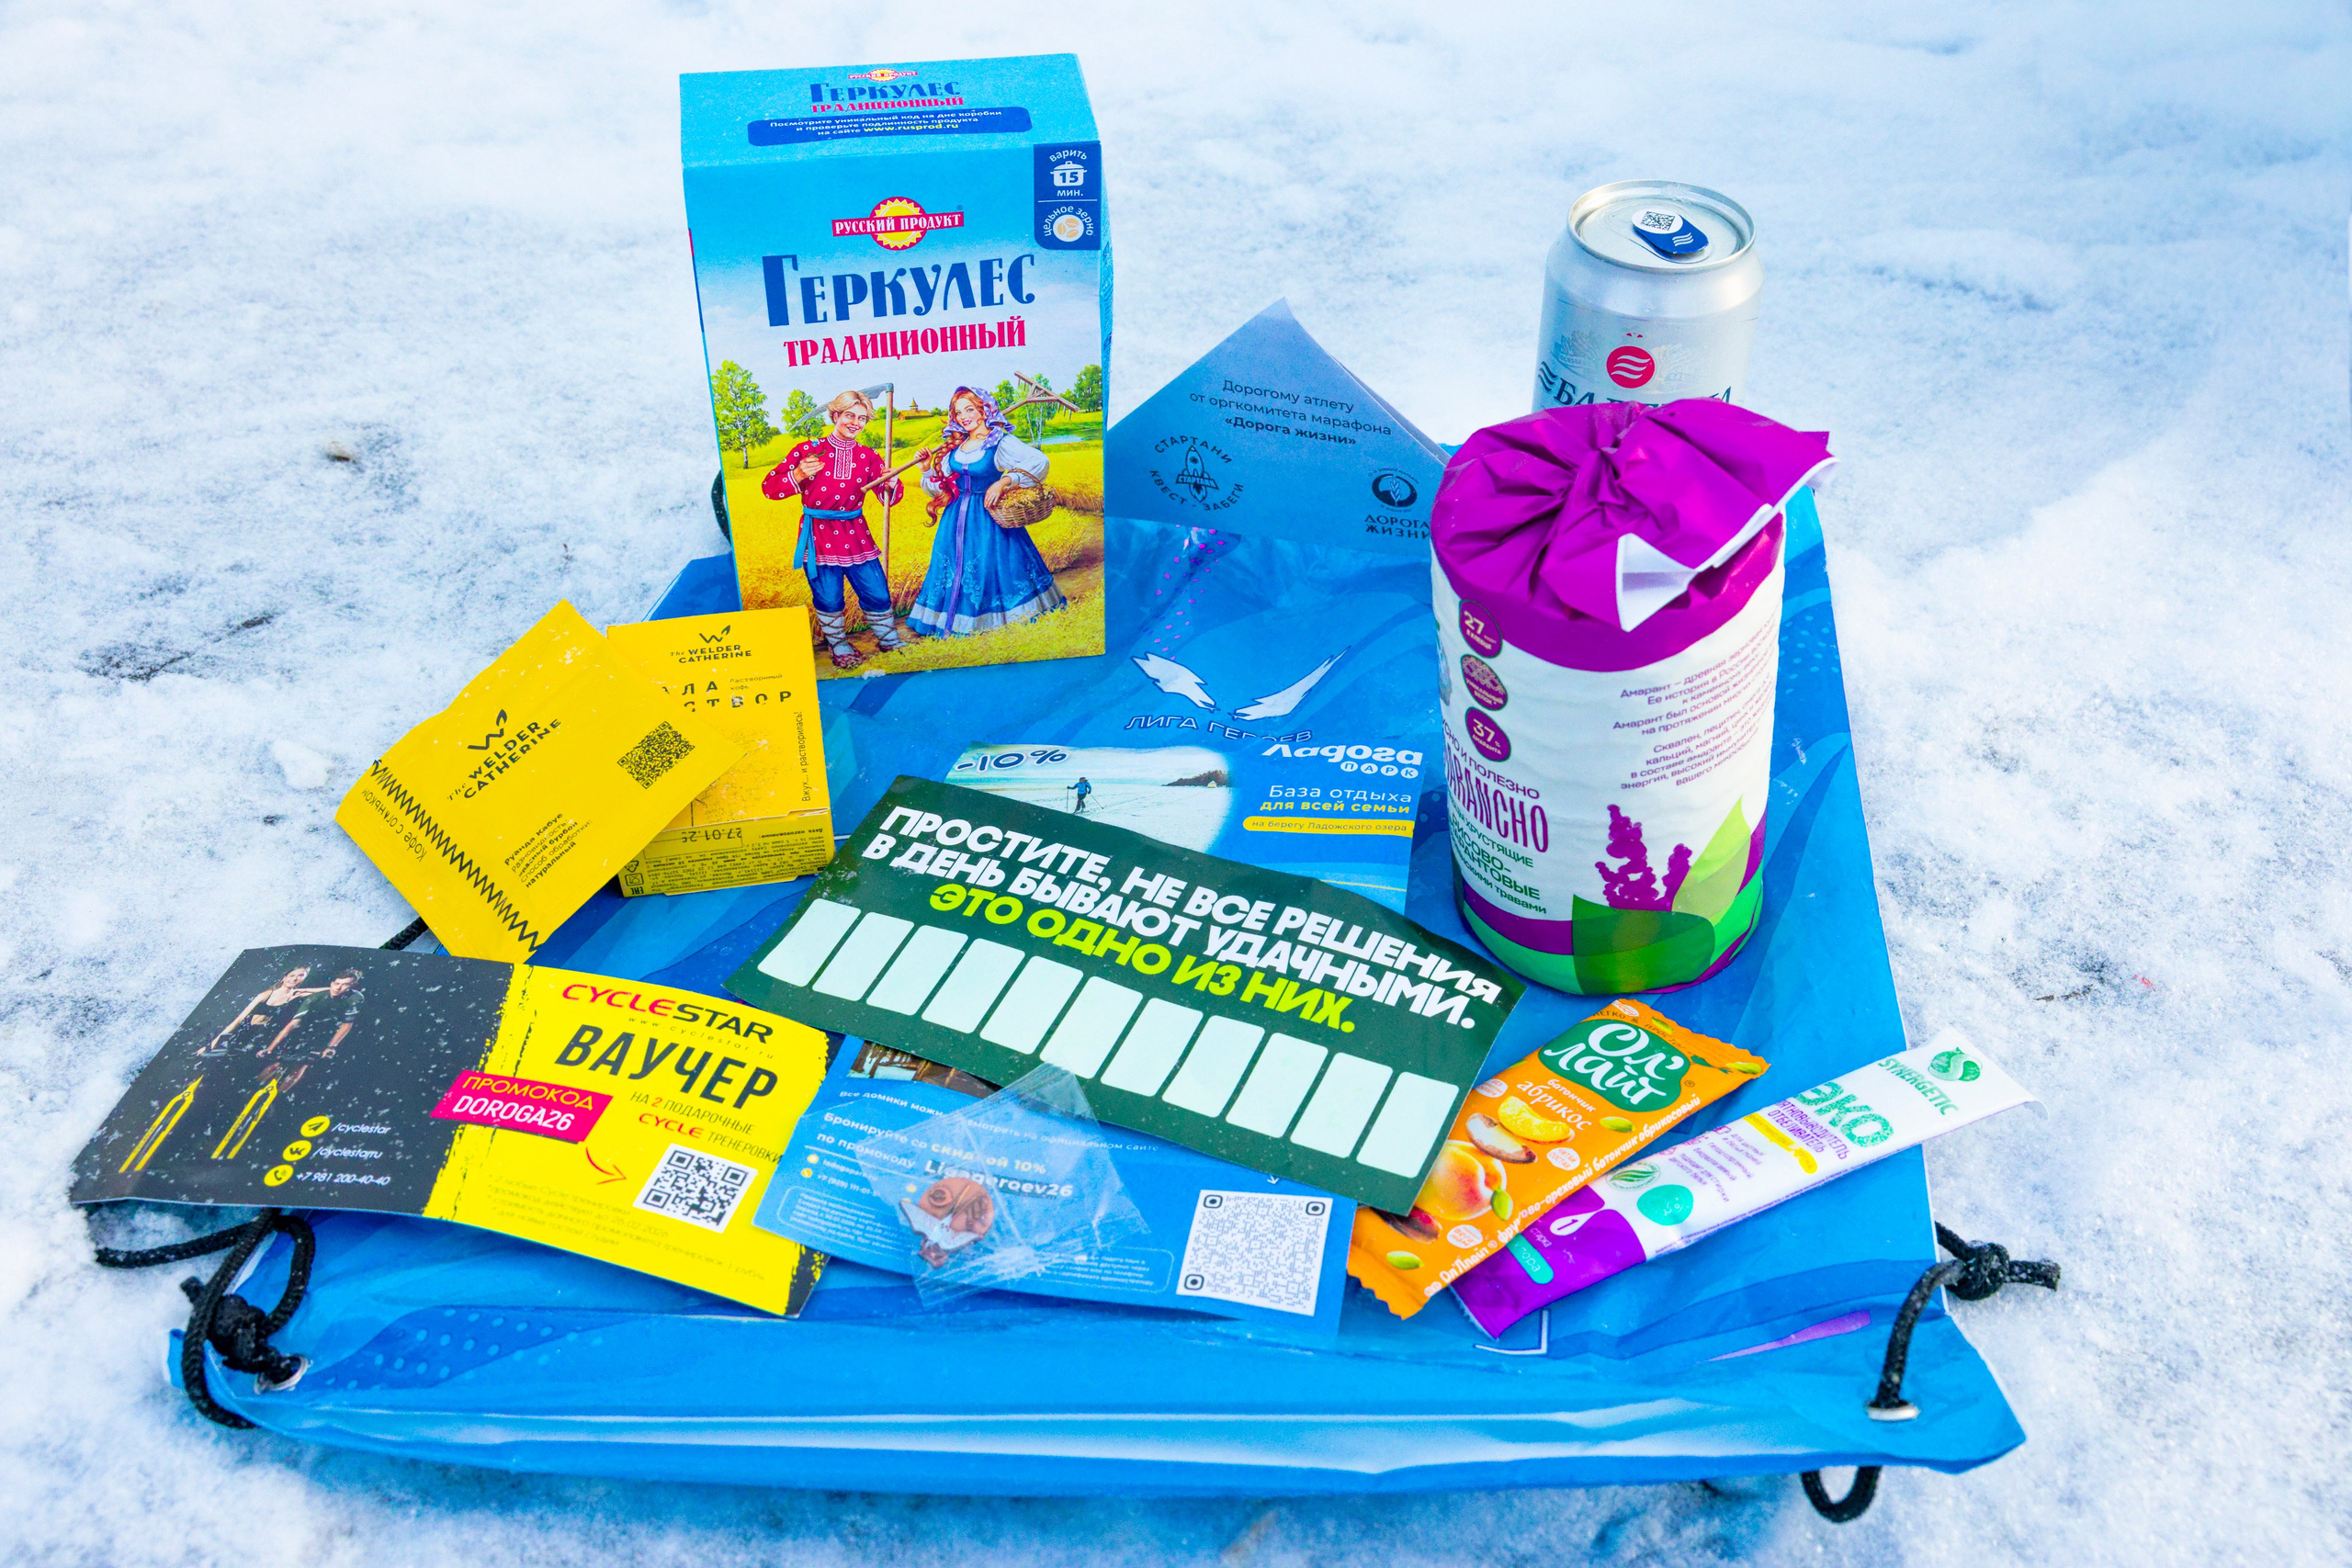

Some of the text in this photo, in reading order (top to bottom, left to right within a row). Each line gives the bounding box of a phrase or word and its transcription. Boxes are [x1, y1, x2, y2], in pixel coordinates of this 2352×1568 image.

[810, 96, 964, 113] ТРАДИЦИОННЫЙ
[770, 119, 832, 128] Посмотрите
[834, 114, 899, 124] уникальный
[806, 123, 859, 131] проверьте
[862, 119, 929, 128] подлинность
[864, 124, 959, 132] www.rusprod.ru
[1049, 149, 1088, 163] варить
[1059, 171, 1079, 184] 15
[835, 214, 962, 234] РУССКИЙ ПРОДУКТ
[1043, 206, 1094, 237] цельное зерно
[762, 253, 1036, 327] ГЕРКУЛЕС
[783, 315, 1026, 367] ТРАДИЦИОННЫЙ
[1223, 379, 1354, 413] Дорогому атлету
[1190, 393, 1392, 435] от оргкомитета марафона
[1225, 416, 1356, 445] «Дорога жизни»
[1154, 434, 1233, 464] СТАРТАНИ
[1149, 469, 1188, 504] КВЕСТ
[1202, 482, 1244, 511] ЗАБЕГИ
[1364, 513, 1430, 530] ДОРОГА
[1365, 524, 1430, 540] ЖИЗНИ
[1464, 610, 1485, 635] 27
[678, 650, 752, 664] CATHERINE
[688, 644, 741, 655] WELDER
[729, 673, 783, 683] Растворимый
[1620, 682, 1671, 699] Амарант
[1647, 694, 1662, 705] Ее
[1665, 679, 1710, 701] история
[1612, 714, 1663, 729] Амарант
[1666, 708, 1688, 720] был
[1690, 686, 1730, 713] основой
[1642, 703, 1722, 736] на протяжении
[1125, 716, 1198, 729] ЛИГА
[1473, 718, 1496, 743] 37
[468, 721, 541, 780] WELDER
[794, 711, 808, 766] растворилась!
[1653, 732, 1702, 753] Сквален,
[464, 718, 561, 799] CATHERINE
[956, 749, 1069, 773] -10%
[1261, 743, 1424, 766] Ладога
[1640, 758, 1684, 776] составе
[1645, 745, 1693, 766] кальций,
[1342, 761, 1417, 778] ПАРК
[1469, 756, 1541, 800] ПОЛЕЗНО
[1621, 754, 1714, 790] энергия, высокий
[1676, 765, 1713, 786] вашего
[1260, 800, 1410, 814] для всей семьи
[1269, 784, 1412, 803] База отдыха
[536, 813, 563, 836] Кабуе
[548, 821, 578, 845] бурбон
[1268, 819, 1305, 830] берегу
[1307, 821, 1373, 831] Ладожского
[1374, 823, 1408, 832] озера
[520, 819, 593, 883] Способ обработки:
[526, 840, 577, 888] натуральный
[879, 806, 1113, 893] ПРОСТИТЕ,
[1119, 866, 1188, 909] НЕ
[1182, 886, 1277, 931] ВСЕ
[1272, 906, 1503, 1005] РЕШЕНИЯ
[1495, 885, 1547, 914] травами
[862, 832, 897, 860] В
[889, 841, 1006, 888] ДЕНЬ
[1007, 866, 1203, 947] БЫВАЮТ
[1203, 924, 1476, 1030] УДАЧНЫМИ.
[929, 883, 1356, 1033] ЭТО ОДНО ИЗ НИХ.
[562, 984, 774, 1044] CYCLESTAR
[628, 1017, 775, 1060] www.cyclestar.ru
[554, 1023, 779, 1110] ВАУЧЕР
[462, 1076, 594, 1111] ПРОМОКОД
[1546, 1078, 1597, 1113] батончик
[1877, 1057, 1959, 1116] SYNERGETIC
[452, 1095, 575, 1132] DOROGA26
[630, 1091, 757, 1136] НА 2 ПОДАРОЧНЫЕ
[862, 1092, 909, 1108] домики
[910, 1102, 944, 1117] можн
[1516, 1080, 1592, 1131] абрикос
[1793, 1081, 1894, 1148] ЭКО
[331, 1122, 392, 1134] /cyclestar
[639, 1112, 705, 1139] CYCLE
[1592, 1135, 1639, 1172] батончик
[1638, 1095, 1702, 1143] абрикосовый
[1767, 1109, 1826, 1154] ОТБЕЛИВАТЕЛЬ
[817, 1133, 835, 1145] по
[838, 1139, 917, 1168] промокоду
[823, 1112, 1046, 1175] Бронируйте со скидой 10%
[296, 1171, 391, 1186] +7 981 200-40-40
[1556, 1218, 1579, 1231] 1
